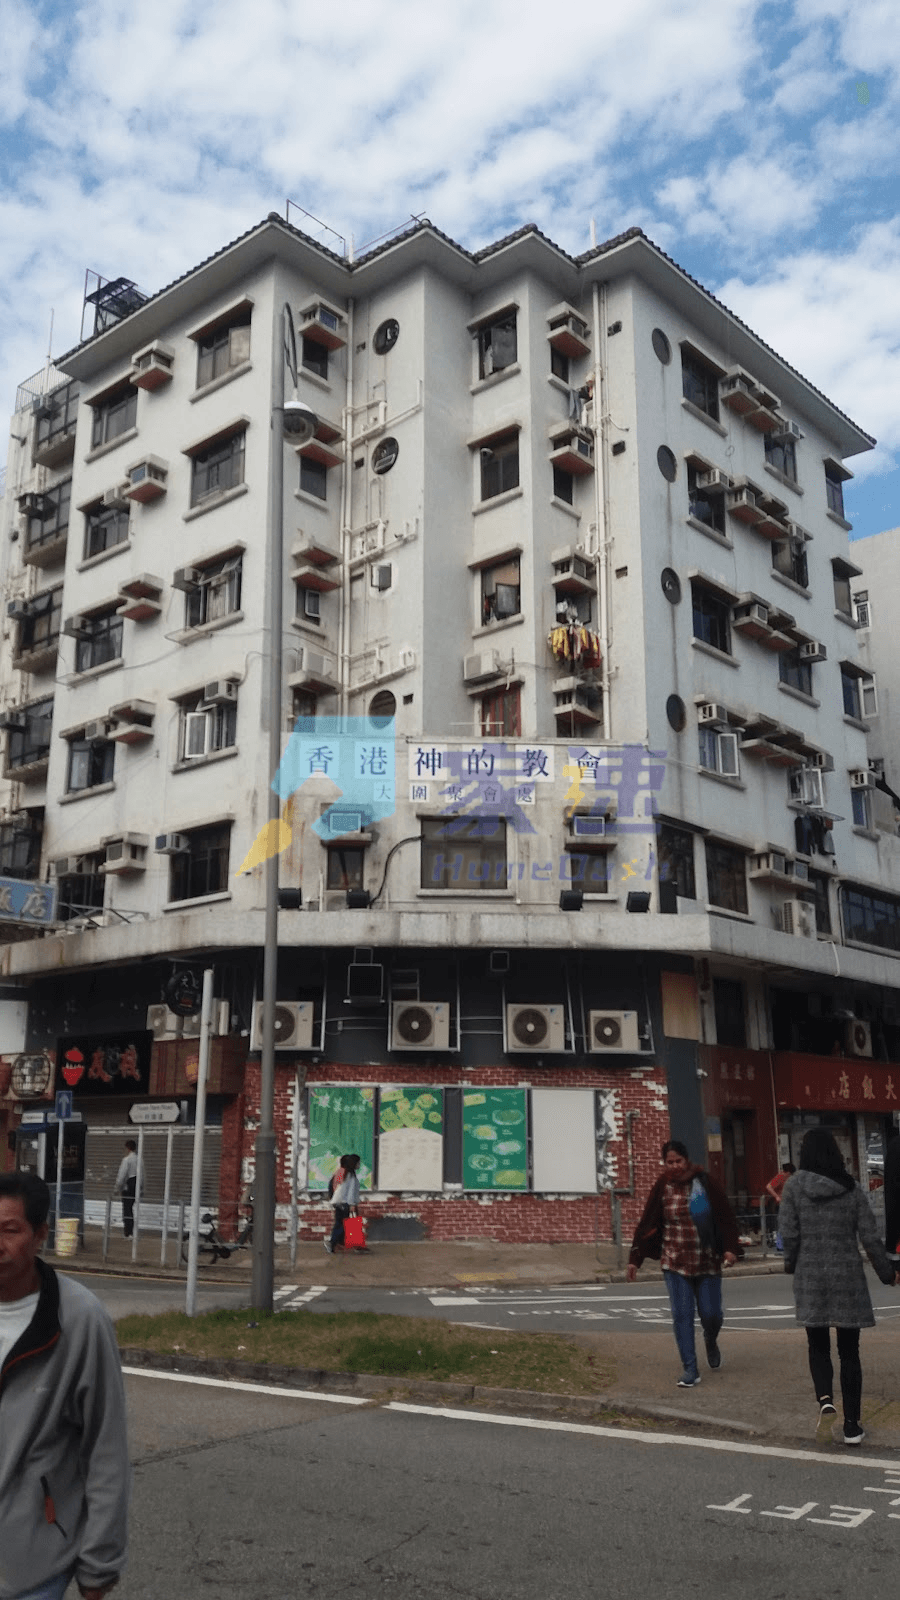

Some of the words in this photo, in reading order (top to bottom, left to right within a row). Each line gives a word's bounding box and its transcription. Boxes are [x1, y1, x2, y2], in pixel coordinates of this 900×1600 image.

[305, 746, 601, 779] 香港神的教會
[376, 784, 533, 803] 大圍聚會處
